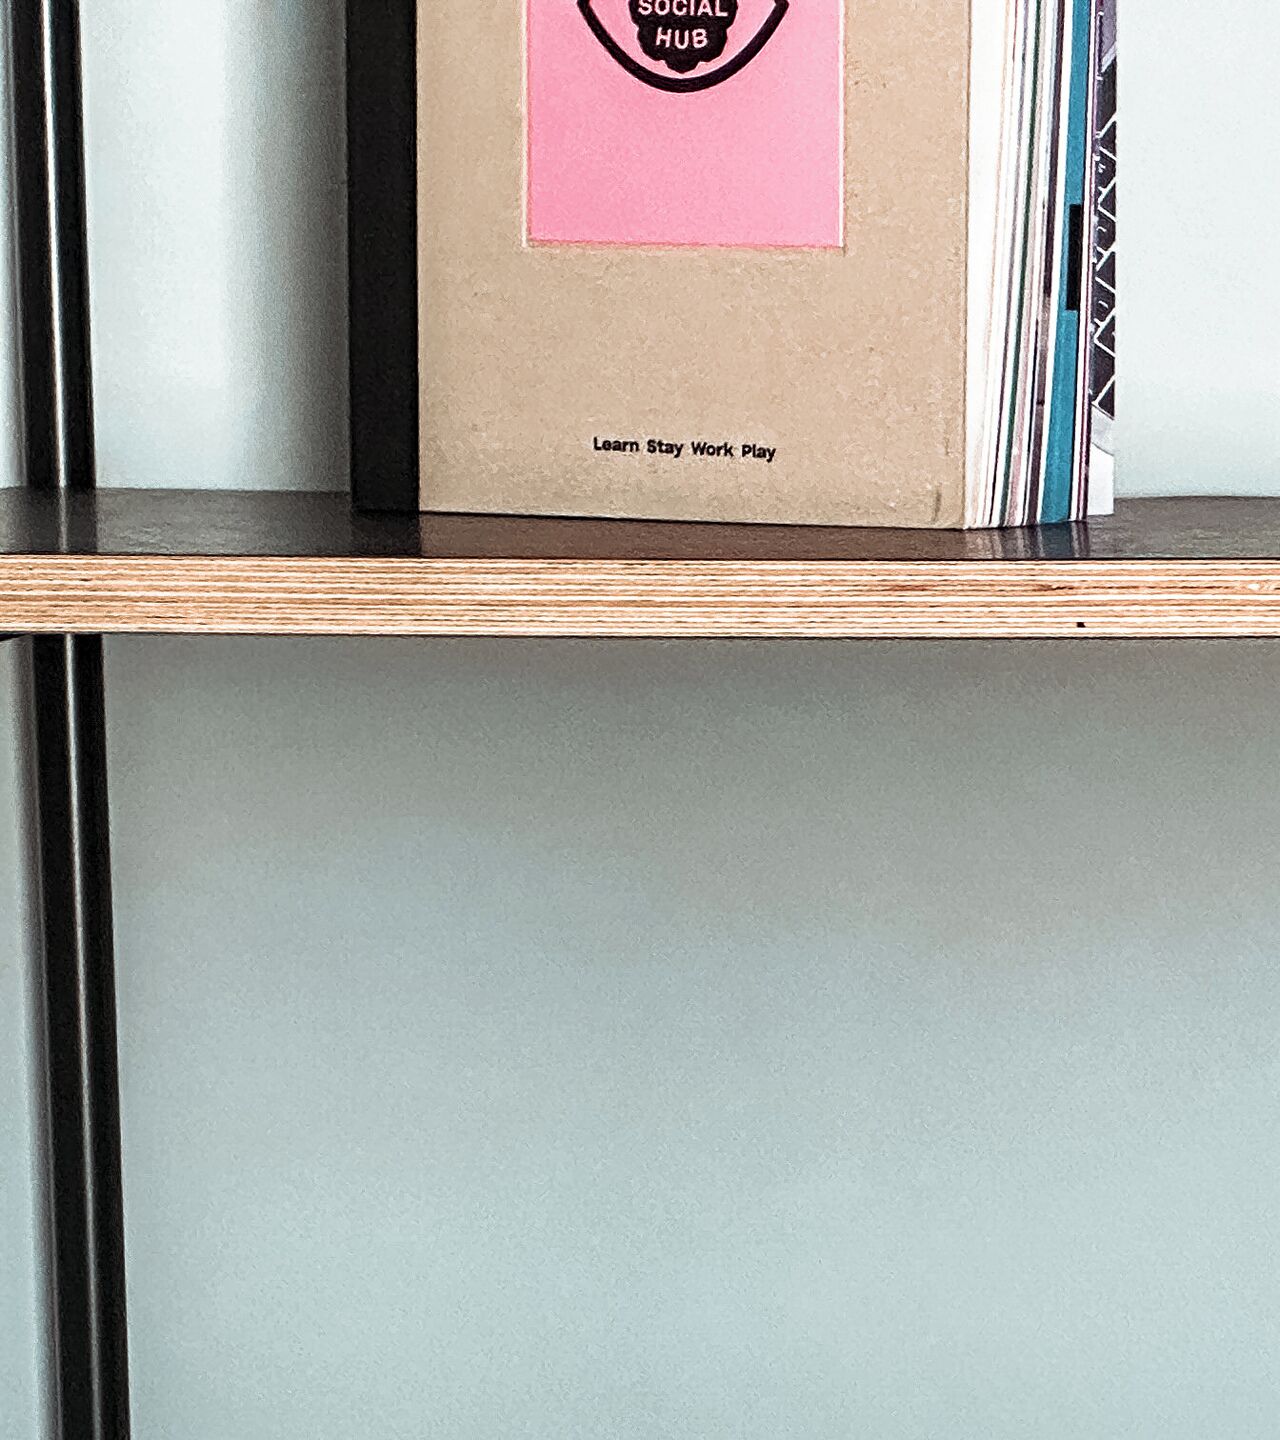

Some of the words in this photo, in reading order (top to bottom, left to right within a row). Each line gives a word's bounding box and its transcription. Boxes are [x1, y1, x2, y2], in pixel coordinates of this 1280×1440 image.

[638, 0, 728, 17] SOCIAL
[655, 26, 708, 49] HUB
[593, 436, 640, 453] Learn
[646, 439, 684, 458] Stay
[691, 441, 734, 457] Work
[742, 443, 776, 463] Play
